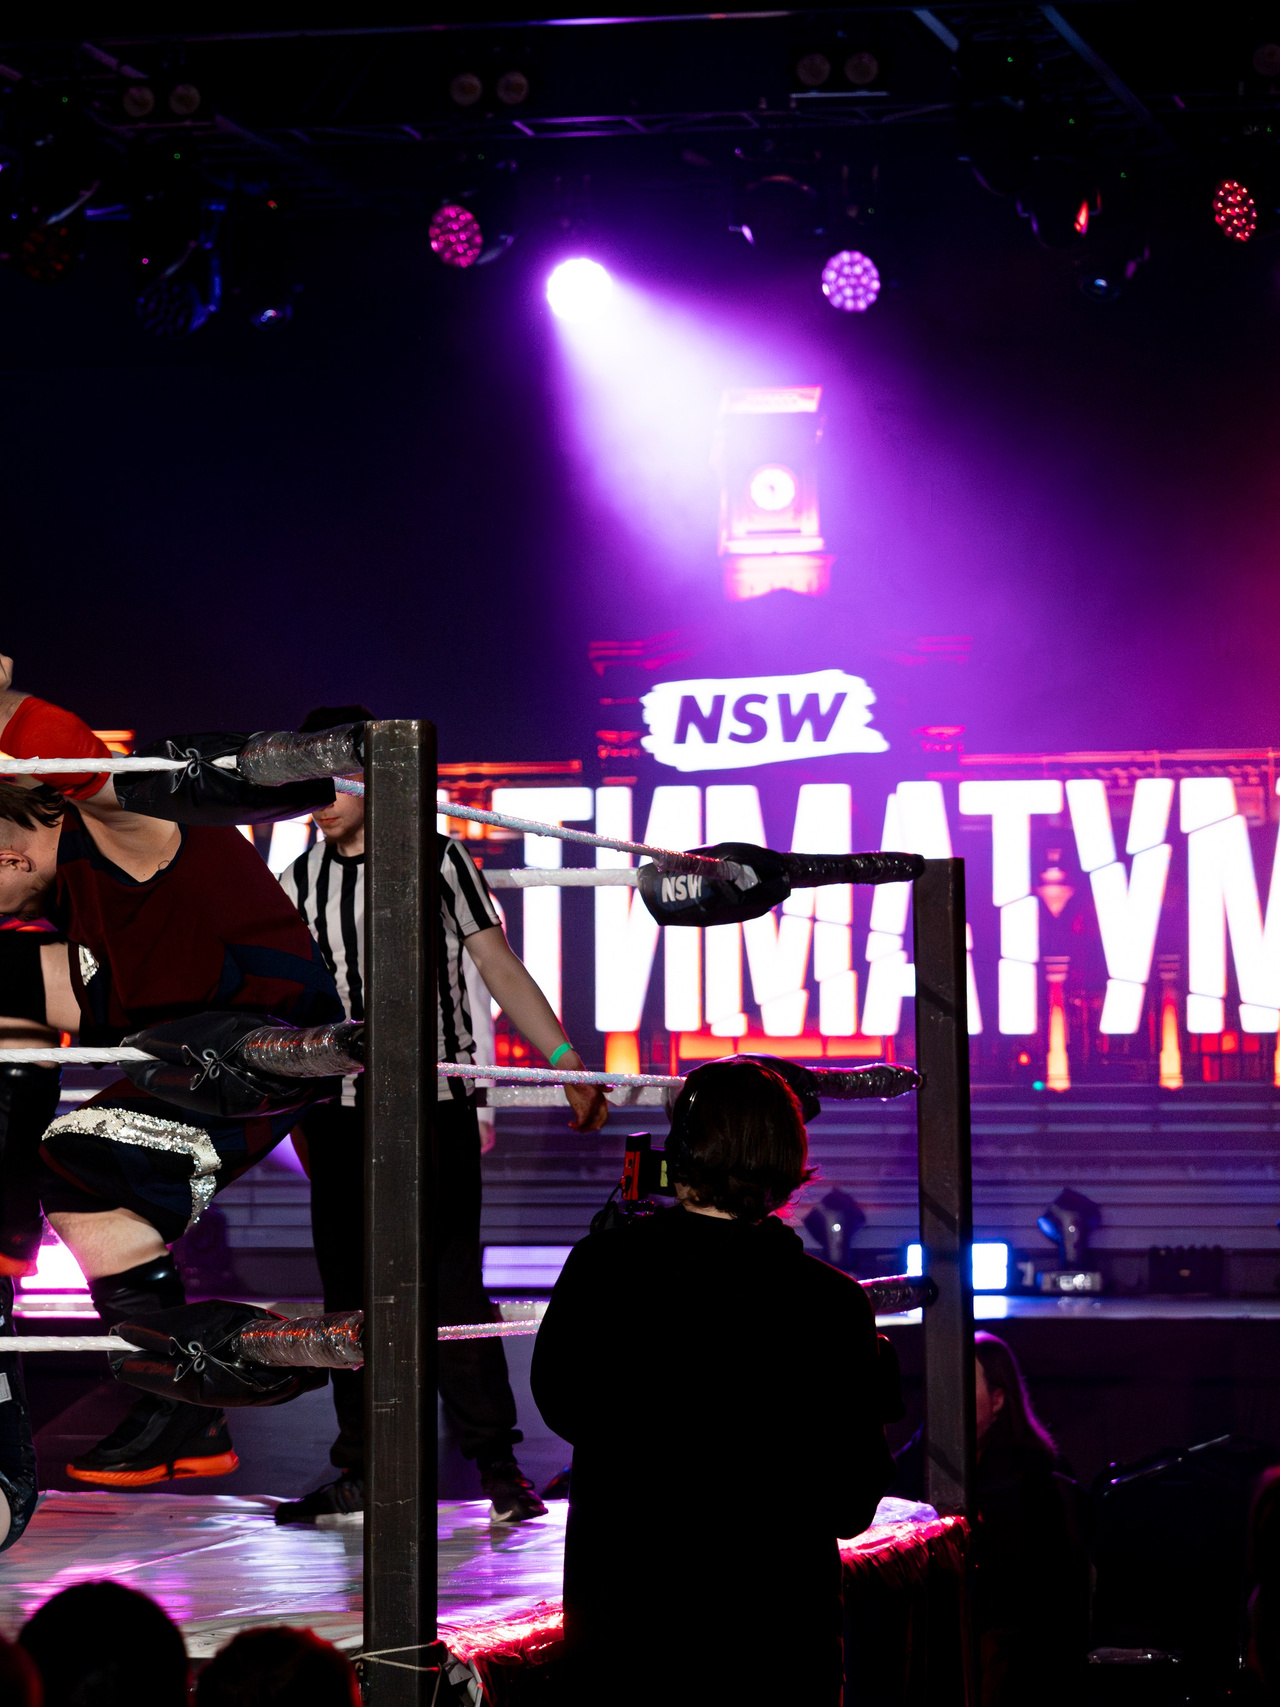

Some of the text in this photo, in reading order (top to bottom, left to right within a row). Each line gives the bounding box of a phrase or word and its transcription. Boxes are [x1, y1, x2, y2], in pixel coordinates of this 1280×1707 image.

[673, 691, 848, 745] NSW
[235, 777, 1280, 1037] ТИМАТУМ
[661, 873, 703, 903] NSW
